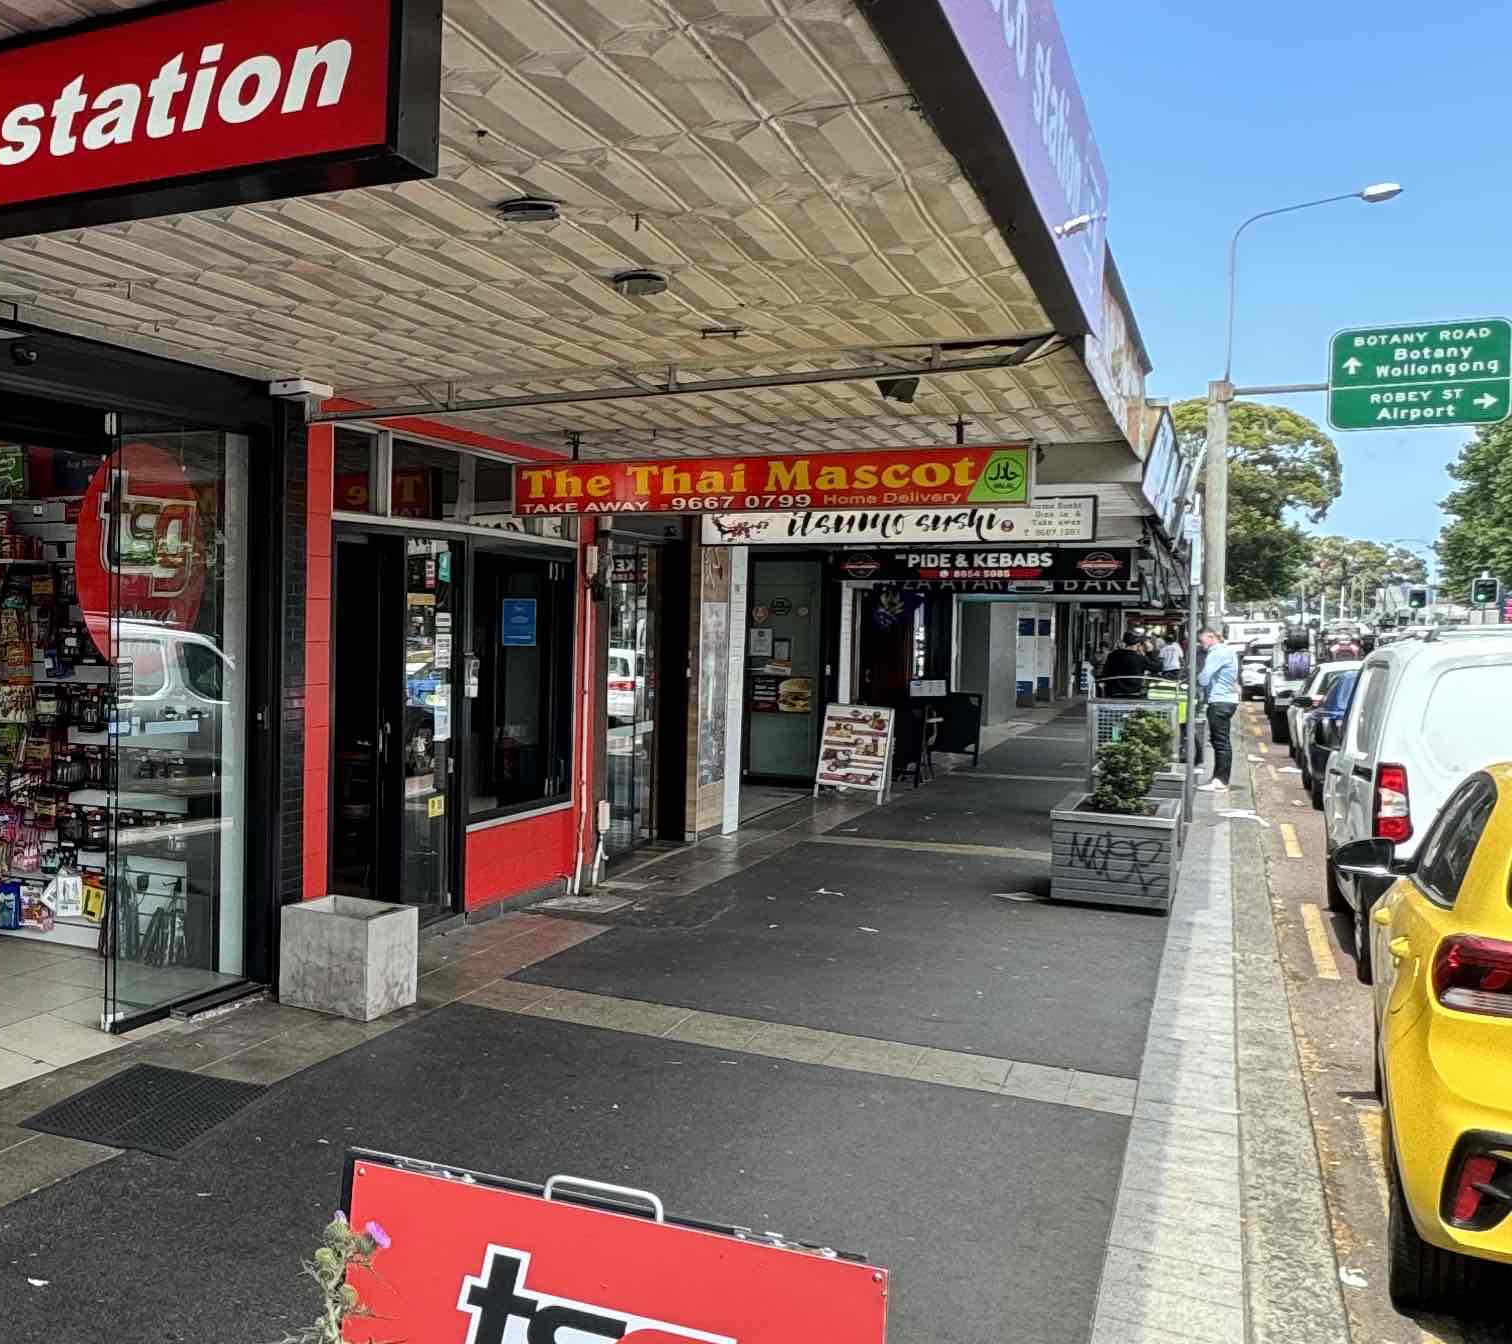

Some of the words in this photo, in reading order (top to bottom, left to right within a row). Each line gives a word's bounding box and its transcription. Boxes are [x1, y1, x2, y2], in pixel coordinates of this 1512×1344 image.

[1032, 42, 1082, 215] station
[1354, 331, 1428, 346] BOTANY
[1440, 327, 1491, 341] ROAD
[1394, 346, 1473, 361] Botany
[1376, 359, 1499, 377] Wollongong
[1370, 391, 1432, 404] ROBEY
[1442, 389, 1464, 400] ST
[1376, 405, 1456, 420] Airport
[522, 469, 612, 499] The
[627, 463, 748, 498] Thai
[764, 456, 978, 493] Mascot
[523, 503, 579, 514] TAKE
[585, 501, 649, 513] AWAY
[671, 496, 736, 512] 9667
[744, 495, 812, 508] 0799
[824, 494, 877, 505] Home
[884, 492, 961, 505] Delivery
[916, 508, 1000, 542] sushi
[908, 554, 952, 567] PIDE
[955, 554, 969, 567] &
[973, 552, 1053, 567] KEBABS
